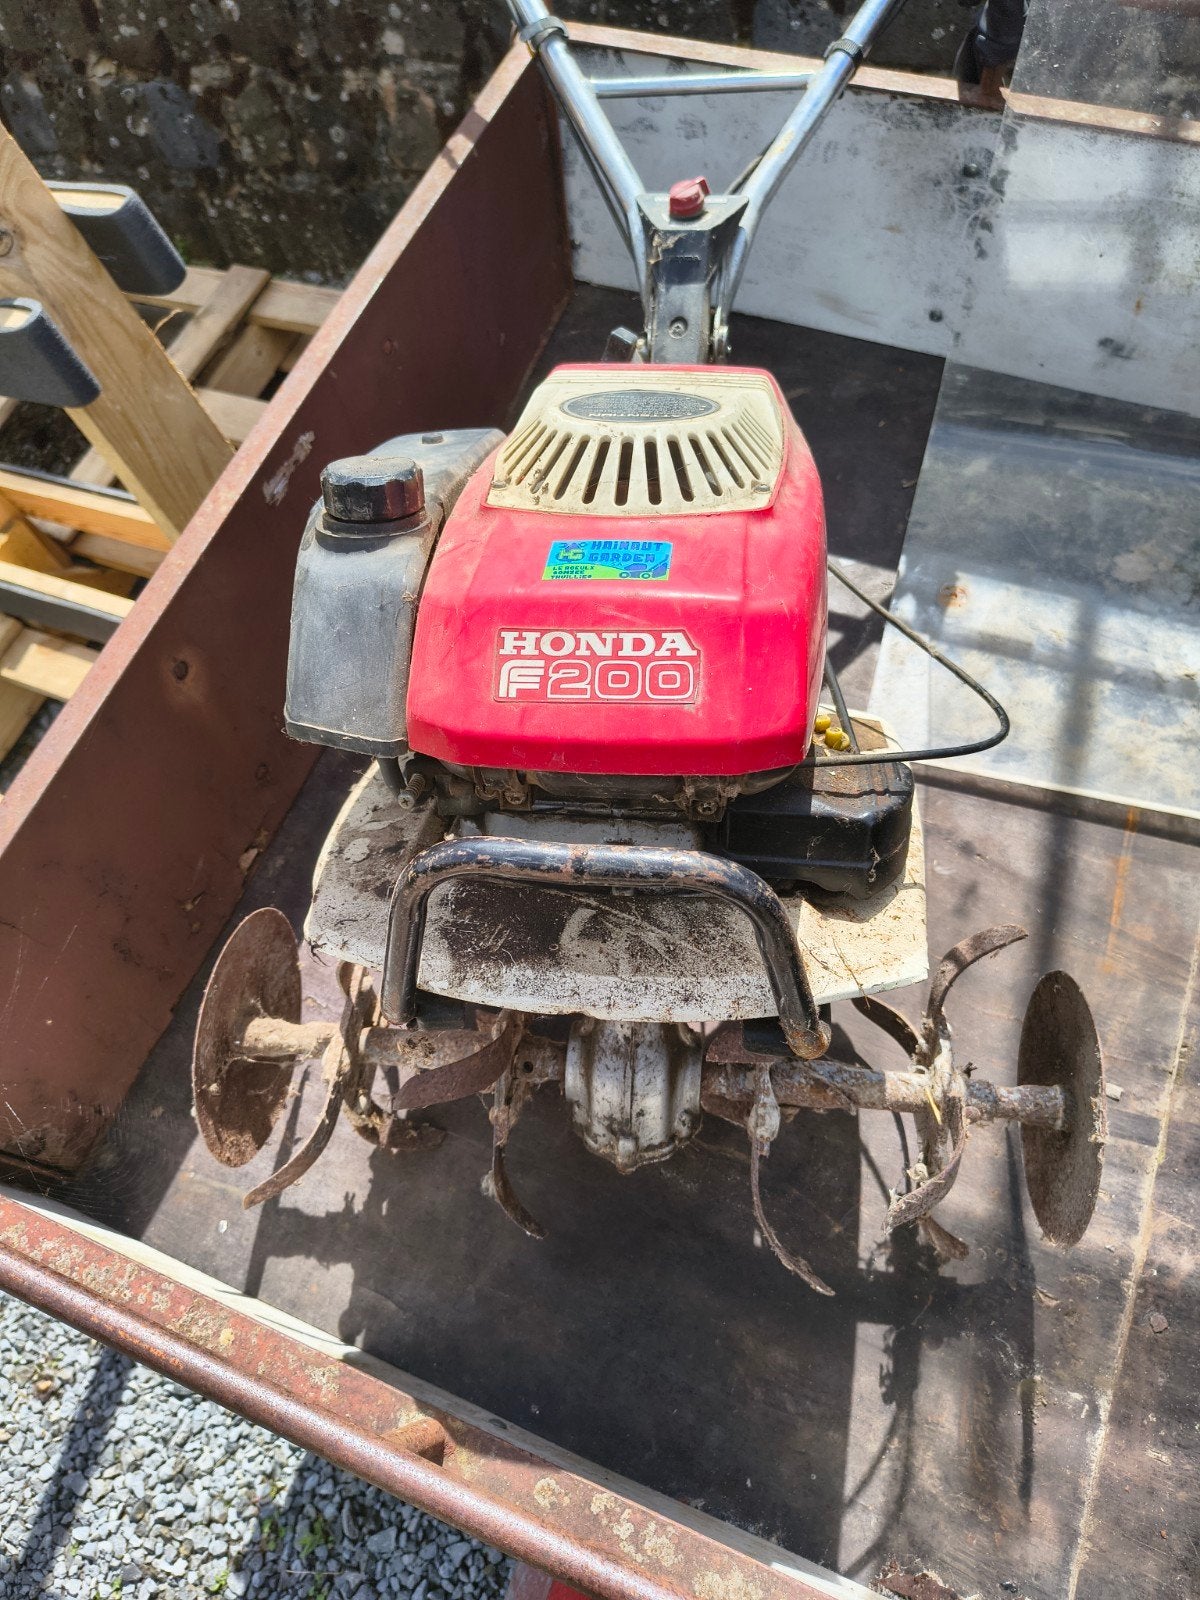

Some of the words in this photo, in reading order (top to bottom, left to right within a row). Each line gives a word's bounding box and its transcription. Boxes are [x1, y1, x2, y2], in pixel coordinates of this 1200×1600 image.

[588, 553, 656, 563] GARDEN
[499, 631, 698, 657] HONDA
[498, 659, 694, 700] F200
